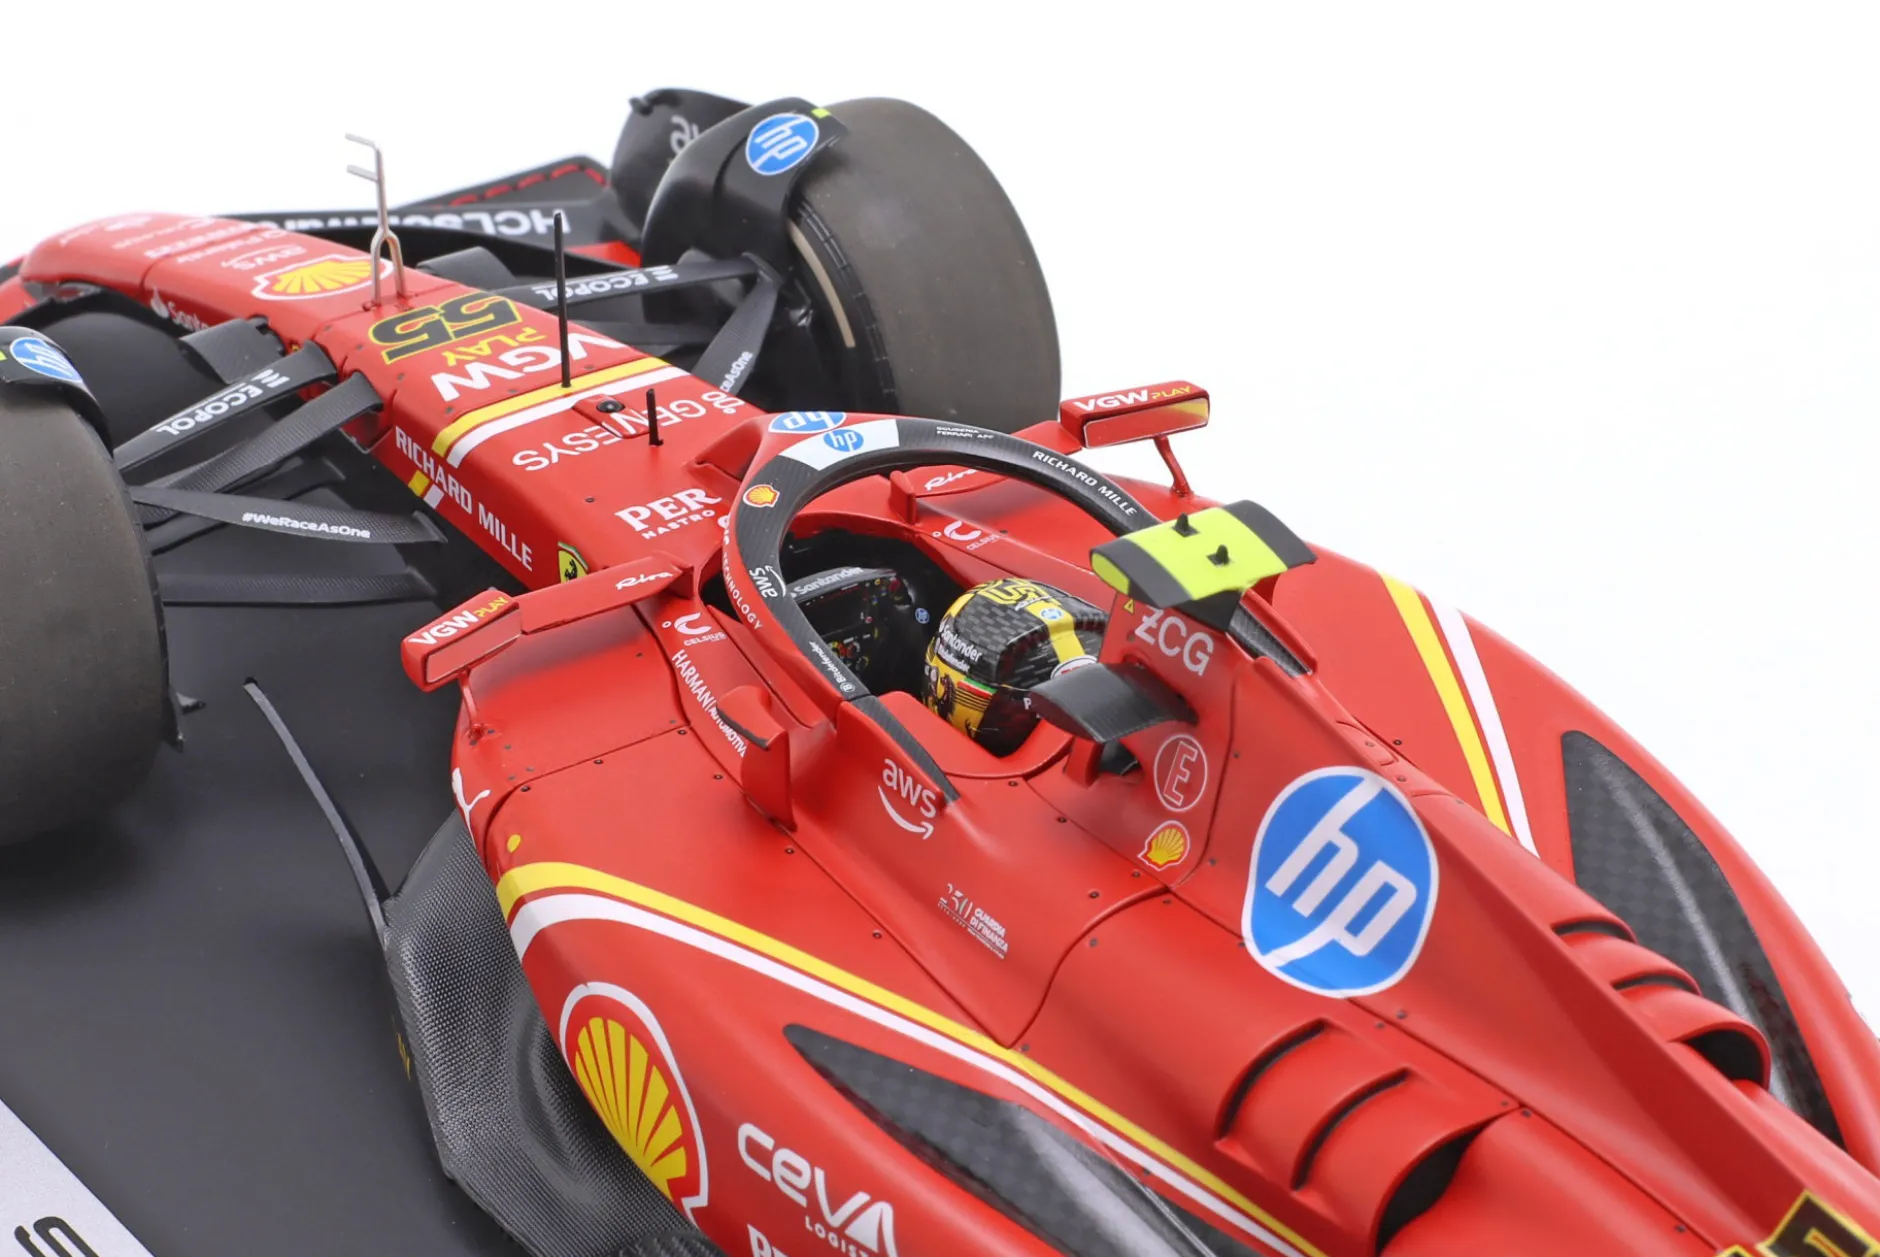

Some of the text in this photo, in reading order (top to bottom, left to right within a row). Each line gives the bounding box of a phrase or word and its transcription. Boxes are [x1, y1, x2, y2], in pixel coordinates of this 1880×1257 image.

[368, 290, 522, 365] 55
[442, 327, 548, 366] PLAY
[431, 332, 629, 402] VGW
[156, 384, 264, 436] ECOPOL
[1073, 386, 1192, 412] VGW PLAY
[512, 399, 707, 472] GENESYS
[395, 426, 533, 572] RICHARD MILLE
[1032, 450, 1138, 517] RICHARD MILLE
[242, 512, 371, 538] #WeRaceAsOne
[641, 509, 716, 540] NASTRO
[748, 567, 779, 598] aws
[794, 566, 865, 595] Santander
[408, 596, 509, 645] VGW PLAY
[683, 631, 727, 646] CELSIUS
[882, 758, 937, 818] aws
[1262, 772, 1418, 968] hp
[974, 907, 1006, 938] GUARDIA
